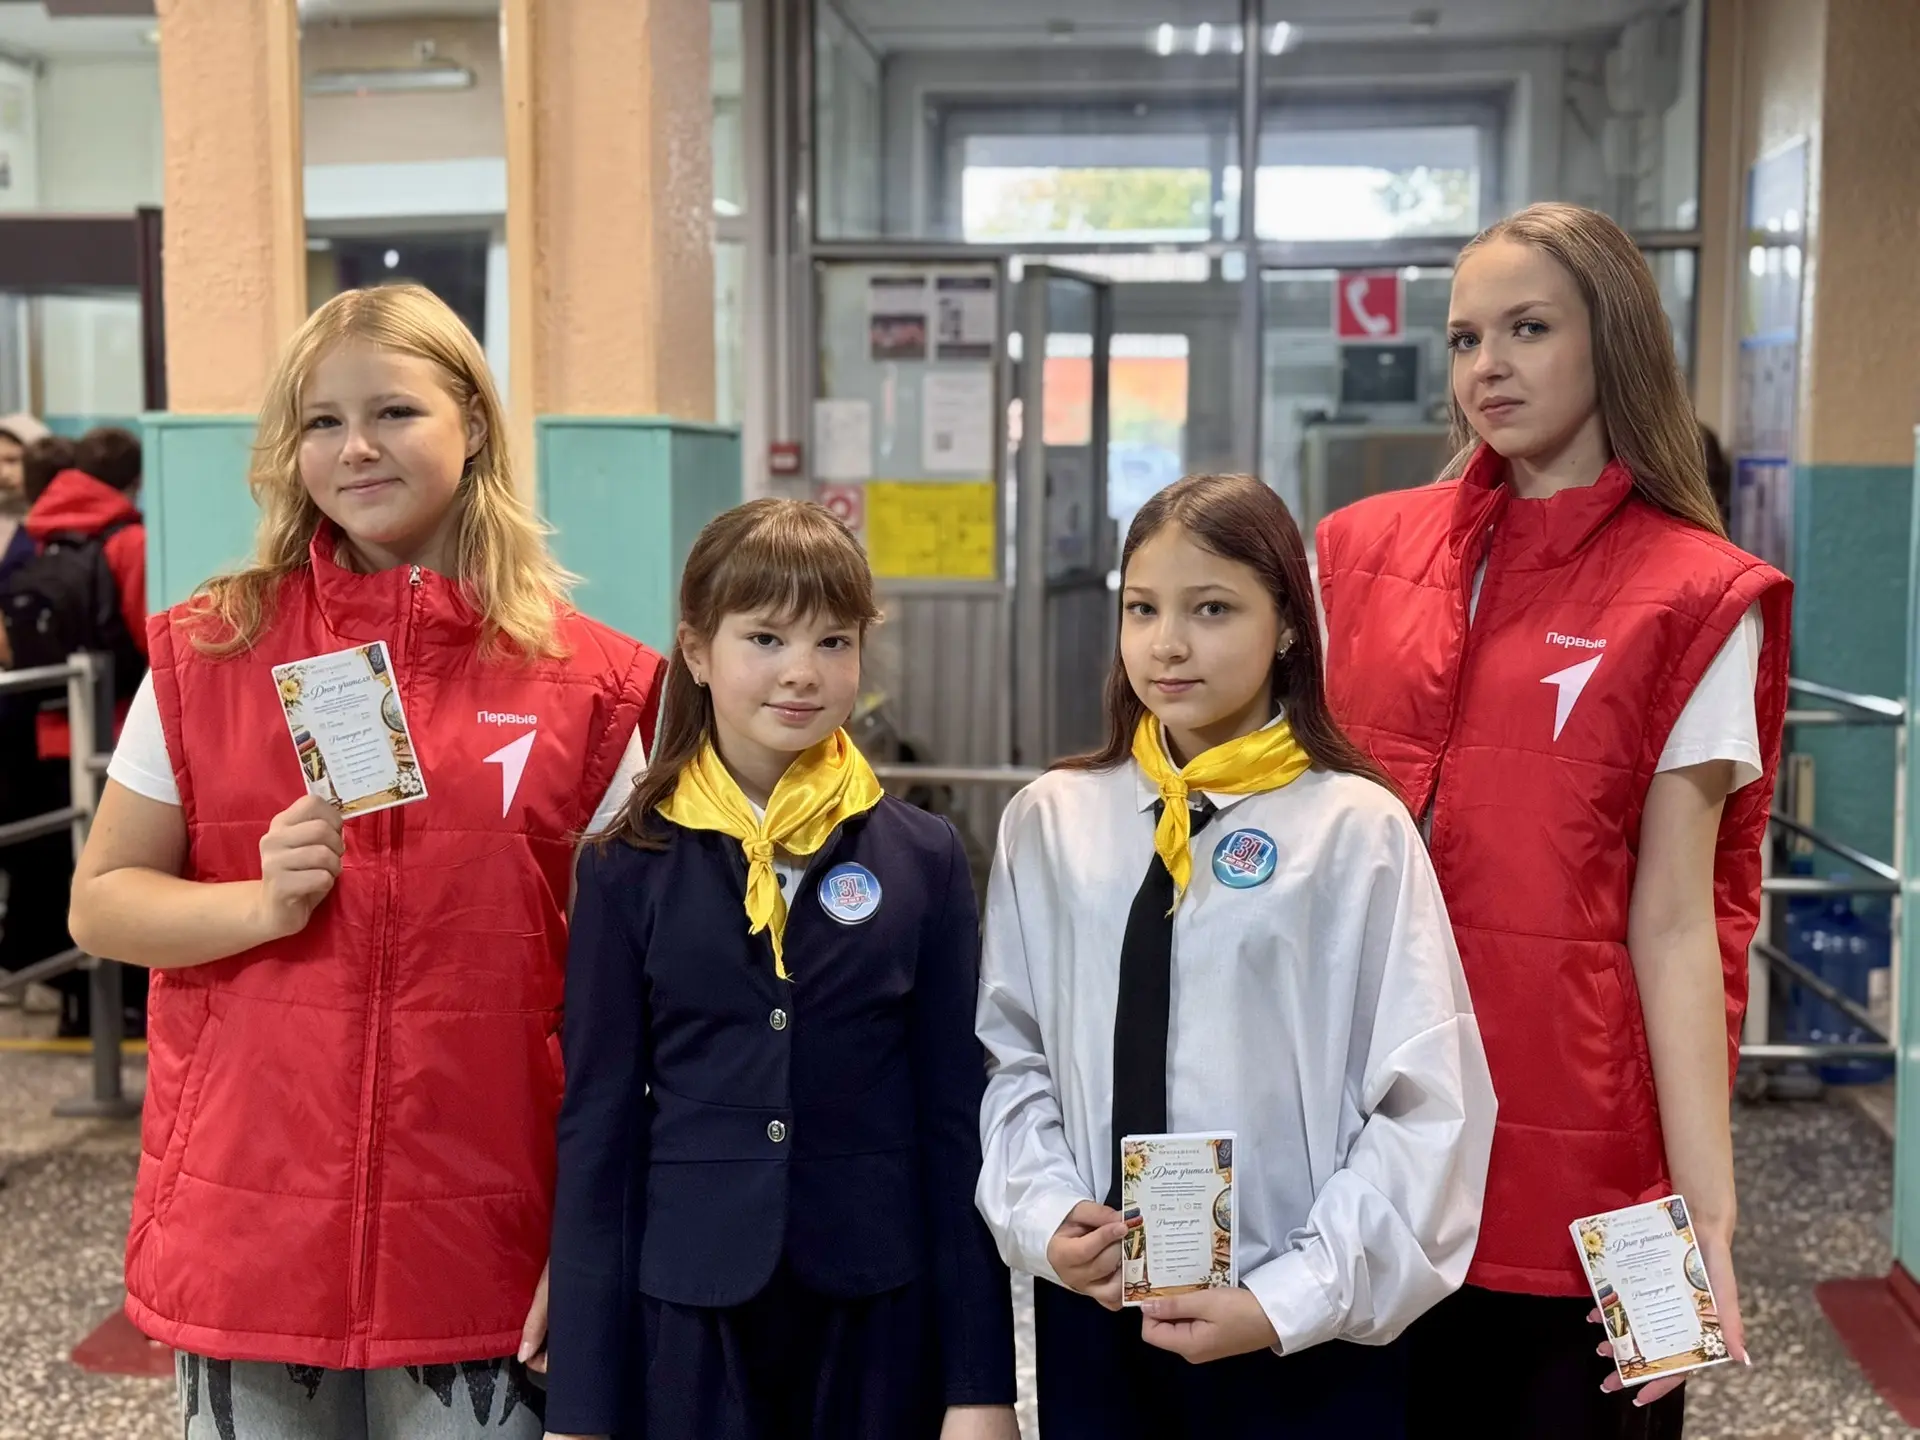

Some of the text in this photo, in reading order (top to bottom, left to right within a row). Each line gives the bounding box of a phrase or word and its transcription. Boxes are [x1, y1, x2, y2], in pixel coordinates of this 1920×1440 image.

[1545, 631, 1607, 649] Первые
[477, 710, 538, 727] Первые
[1233, 835, 1263, 861] 31
[837, 876, 857, 898] 31
